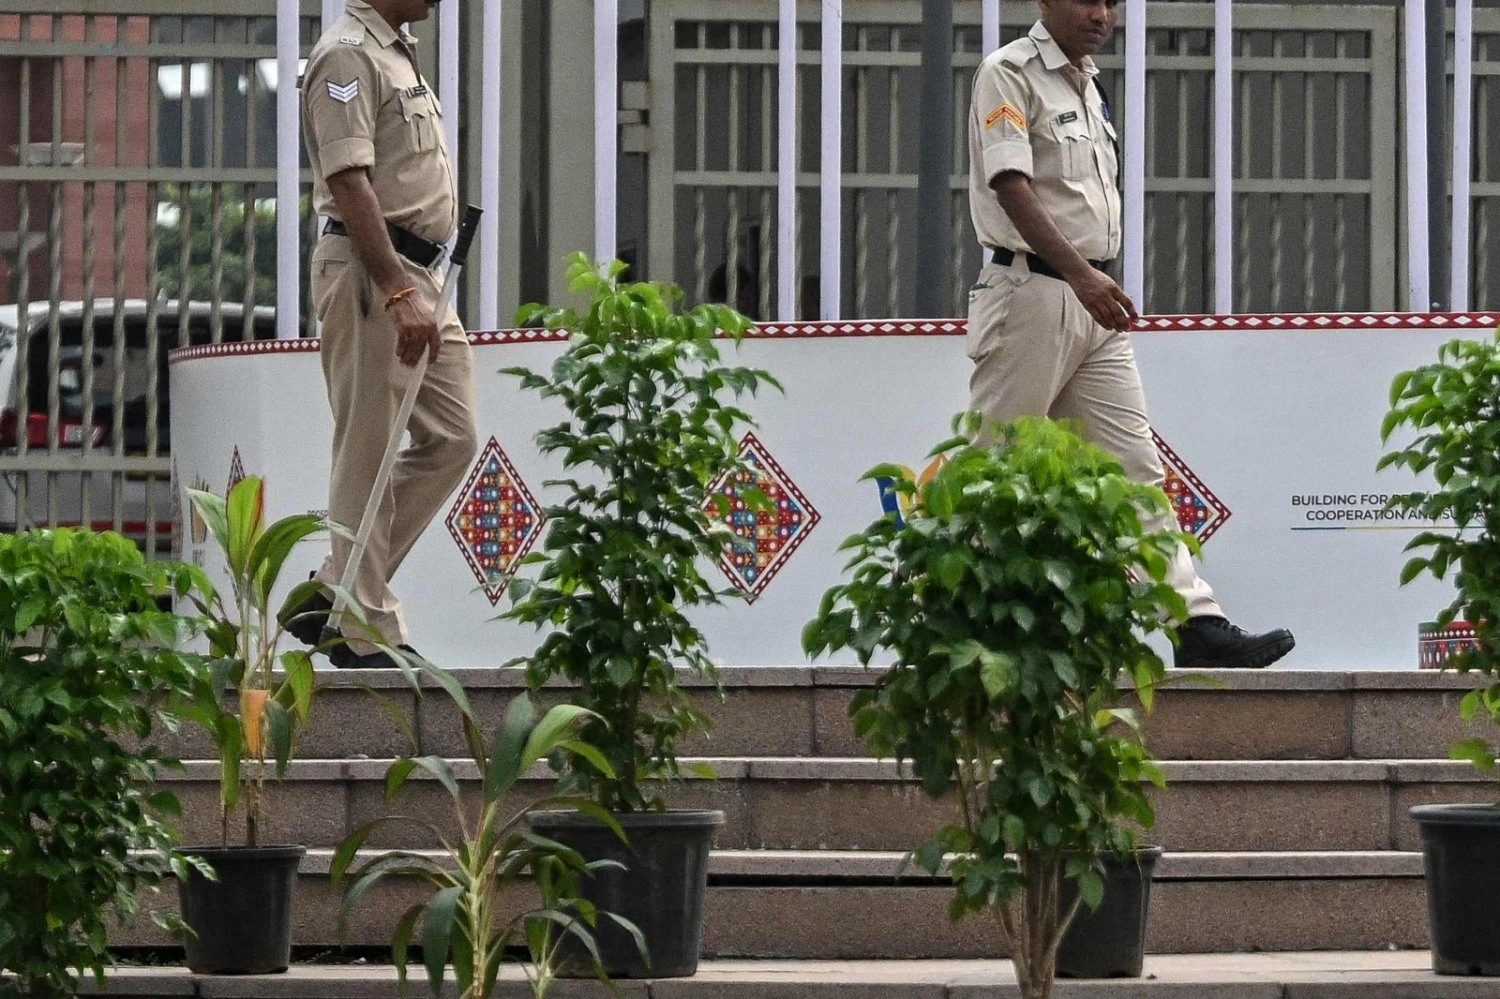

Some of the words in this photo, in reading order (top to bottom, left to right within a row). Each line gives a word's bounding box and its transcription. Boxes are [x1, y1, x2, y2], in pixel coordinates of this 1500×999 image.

[1291, 495, 1357, 506] BUILDING
[1360, 494, 1388, 505] FOR
[1306, 509, 1405, 521] COOPERATION
